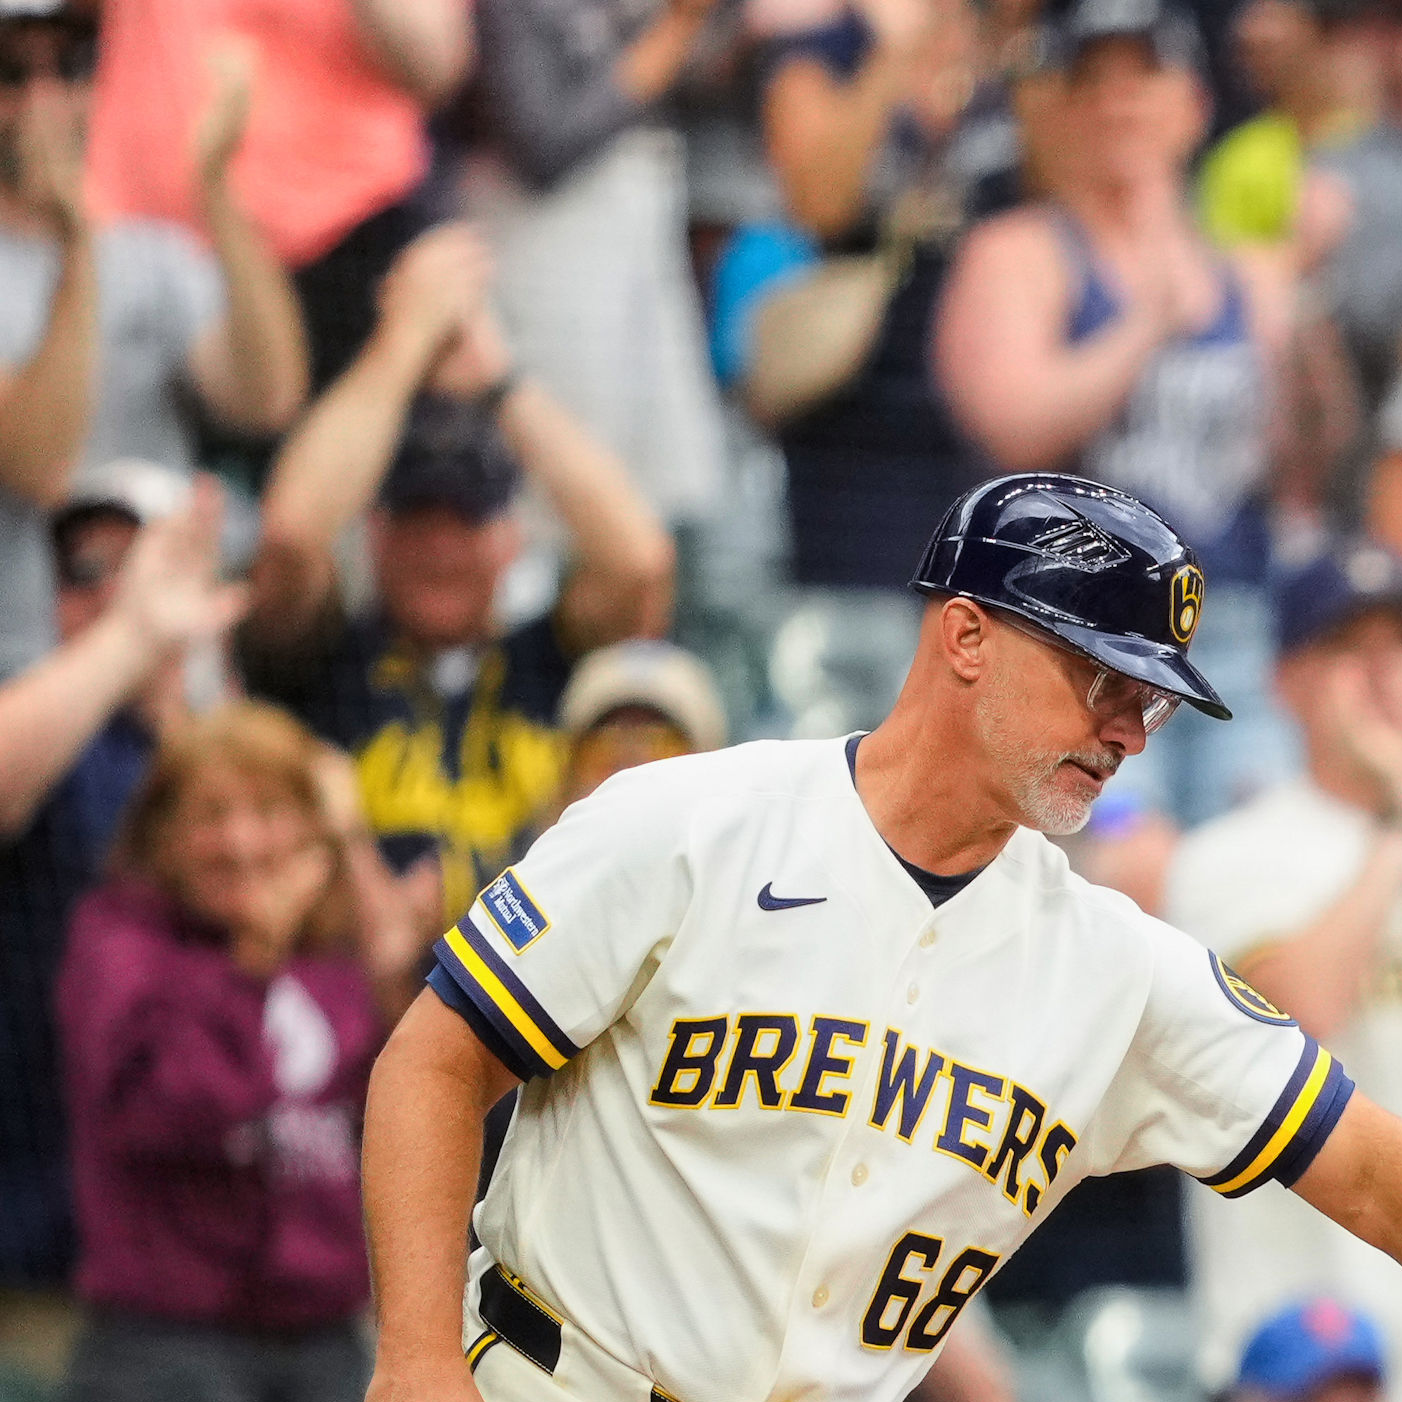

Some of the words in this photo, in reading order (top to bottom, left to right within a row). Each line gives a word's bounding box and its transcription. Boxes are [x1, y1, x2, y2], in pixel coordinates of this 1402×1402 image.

[493, 895, 517, 925] Mutual
[501, 886, 540, 937] Northwestern
[649, 1012, 1080, 1218] BREWERS
[859, 1229, 1001, 1354] 68
